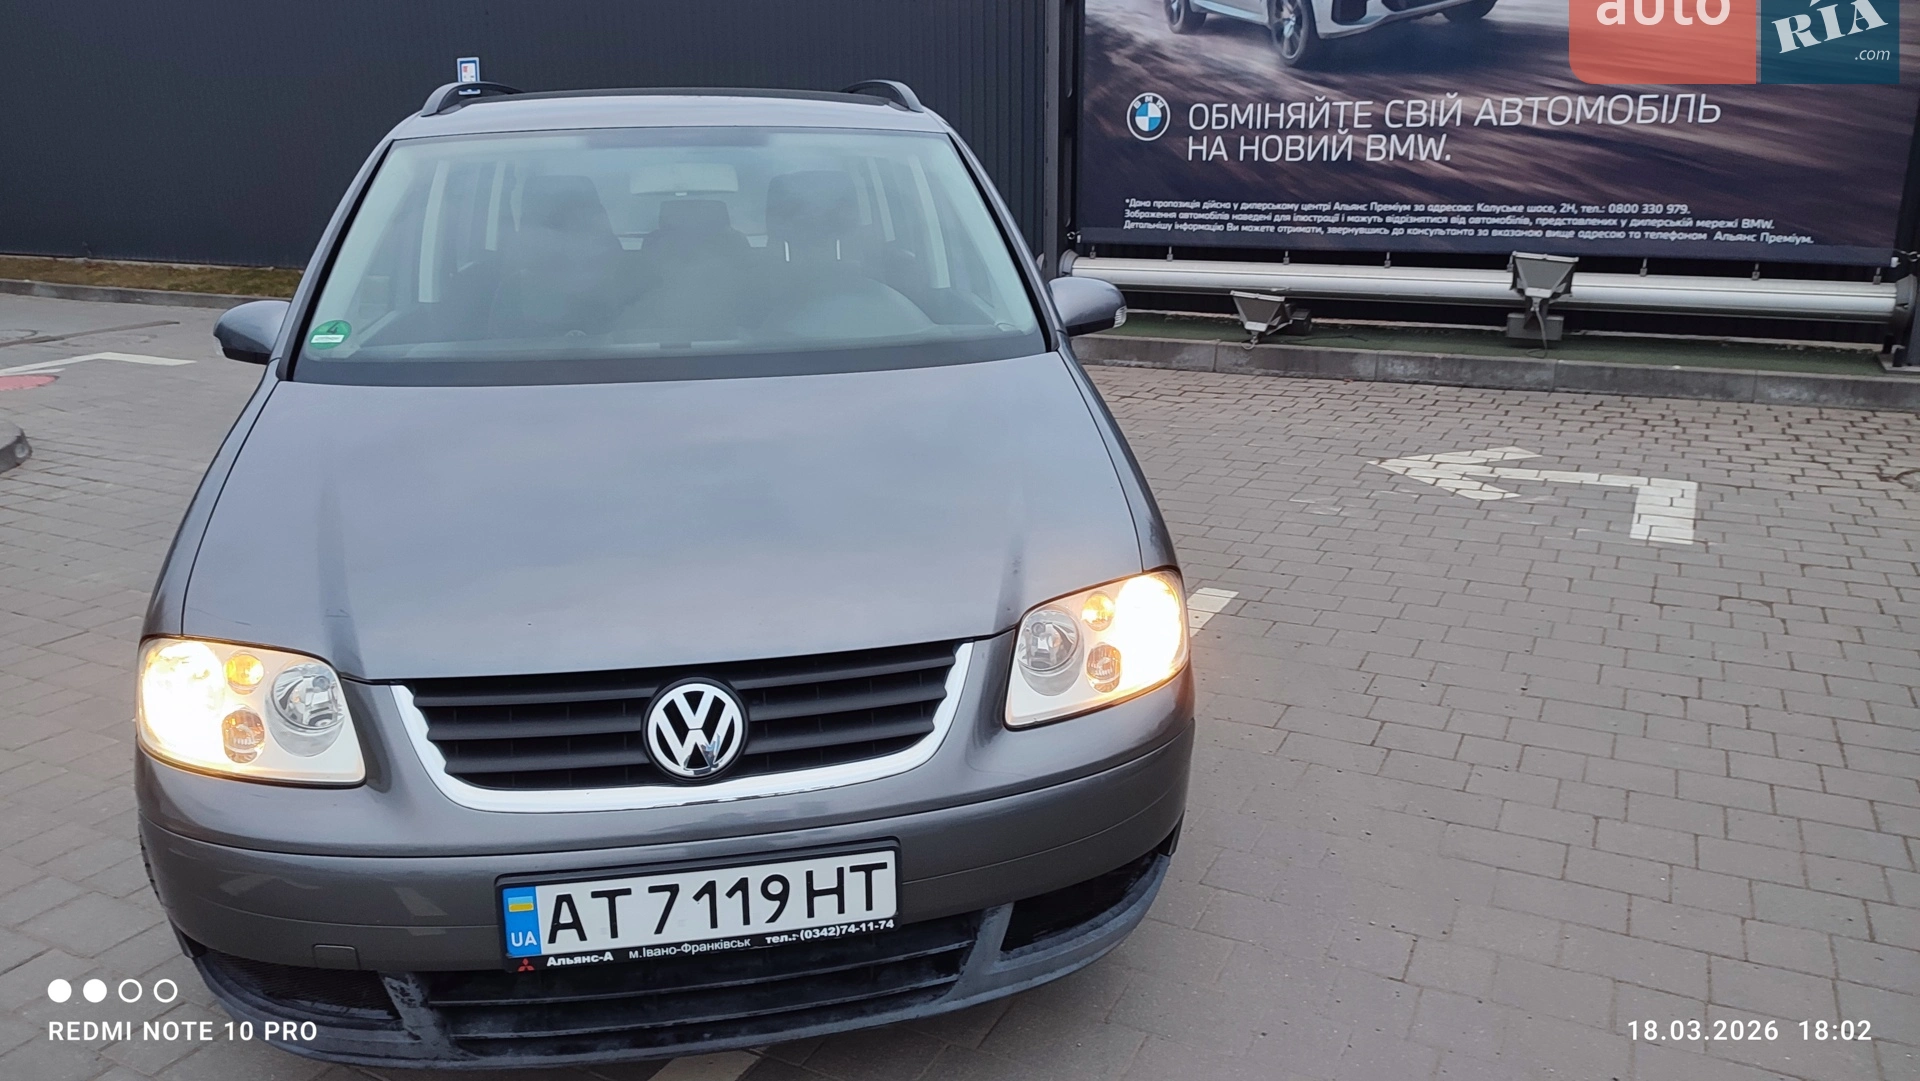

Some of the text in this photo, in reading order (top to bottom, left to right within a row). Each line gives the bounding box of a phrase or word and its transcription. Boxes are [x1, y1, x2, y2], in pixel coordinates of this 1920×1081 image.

[1188, 92, 1721, 130] ОБМІНЯЙТЕ СВІЙ АВТОМОБІЛЬ
[1187, 128, 1451, 162] НА НОВИЙ BMW.
[1124, 209, 1177, 220] Зображення
[1178, 210, 1230, 221] автомобілів
[1232, 211, 1272, 222] наведені
[1274, 213, 1291, 222] для
[1293, 211, 1339, 223] ілюстрації
[1347, 215, 1383, 225] можуть
[1385, 213, 1449, 225] відрізнятися
[1450, 214, 1466, 226] від
[1535, 216, 1618, 227] представлених
[1620, 218, 1626, 228] у
[1629, 216, 1693, 228] дилерській
[1696, 218, 1738, 229] мережі
[1741, 218, 1775, 229] BMW.
[1153, 199, 1200, 210] пропозиція
[1202, 199, 1230, 210] дійсна
[1232, 202, 1238, 211] у
[1240, 201, 1299, 212] дилерському
[1301, 201, 1331, 212] центрі
[1333, 201, 1368, 212] Альянс
[1370, 201, 1411, 213] Преміум
[1413, 204, 1425, 212] за
[1477, 203, 1524, 214] Калуське
[1527, 204, 1556, 215] шосе,
[1608, 203, 1639, 214] 0800
[1641, 204, 1664, 214] 330
[1666, 204, 1691, 215] 979.
[1123, 220, 1173, 231] Детальнішу
[1174, 221, 1225, 232] інформацію
[1226, 222, 1240, 231] Ви
[1241, 224, 1275, 233] можете
[1327, 226, 1390, 236] звернувшись
[1391, 227, 1405, 236] до
[1407, 227, 1475, 237] консультанта
[1477, 229, 1489, 237] за
[1491, 229, 1543, 238] вказаною
[1545, 229, 1575, 239] вище
[1577, 231, 1626, 240] адресою
[1628, 231, 1641, 239] та
[1644, 231, 1707, 241] телефоном
[1713, 231, 1757, 242] Альянс
[1759, 232, 1814, 245] Преміум.
[647, 683, 743, 776] VW
[647, 874, 790, 935] 7119
[510, 931, 537, 947] UA
[547, 951, 614, 967] Альянс-А
[628, 938, 751, 959] м.Івано-Франківськ
[800, 919, 895, 942] (0342)74-11-74
